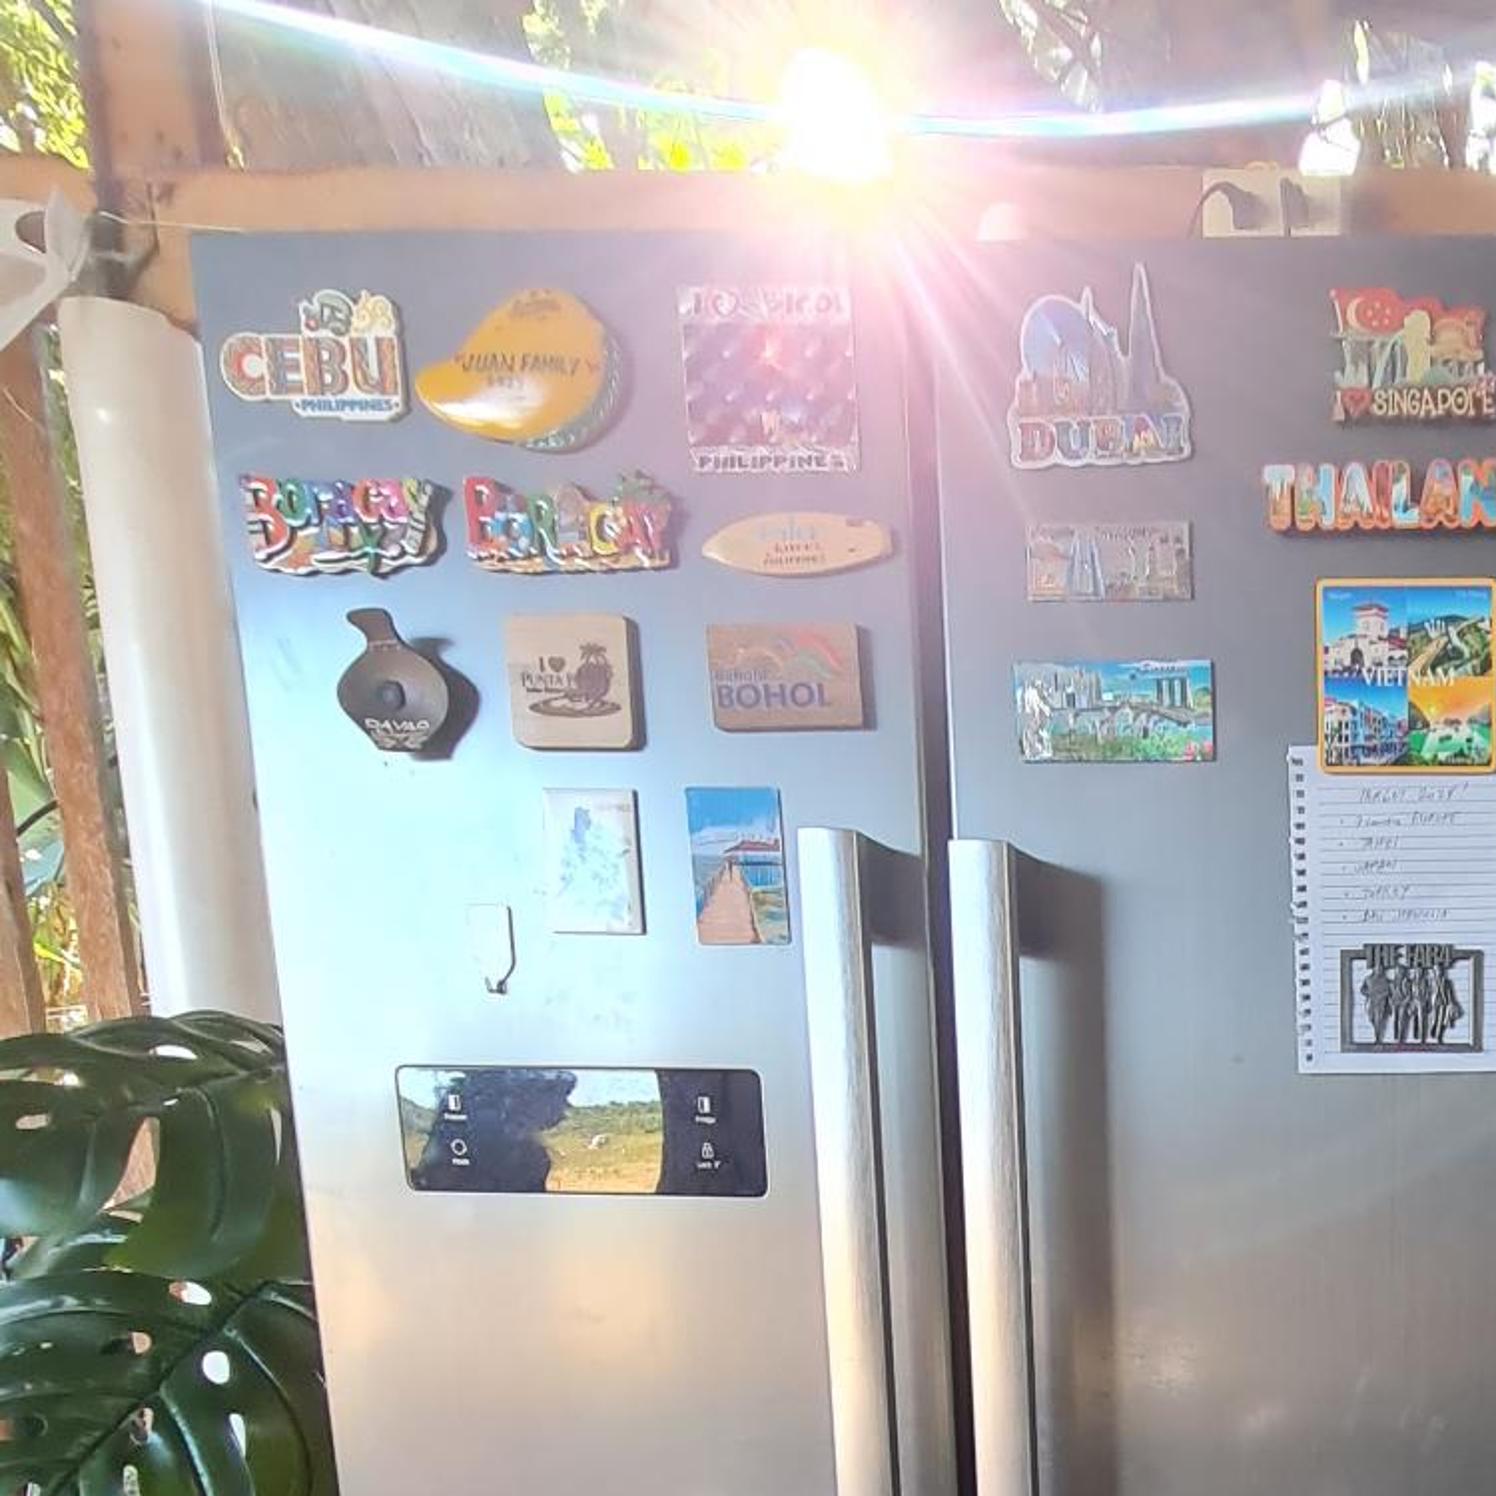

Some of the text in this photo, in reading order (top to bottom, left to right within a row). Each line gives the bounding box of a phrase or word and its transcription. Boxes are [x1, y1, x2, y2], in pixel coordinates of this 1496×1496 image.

[222, 334, 399, 400] CEBU
[1373, 387, 1496, 418] SINGAPORE
[1018, 416, 1187, 461] DUBAI
[699, 454, 845, 470] PHILIPPINES
[538, 655, 546, 673] I
[1362, 667, 1457, 688] VIETNAM
[716, 682, 831, 710] BOHOL
